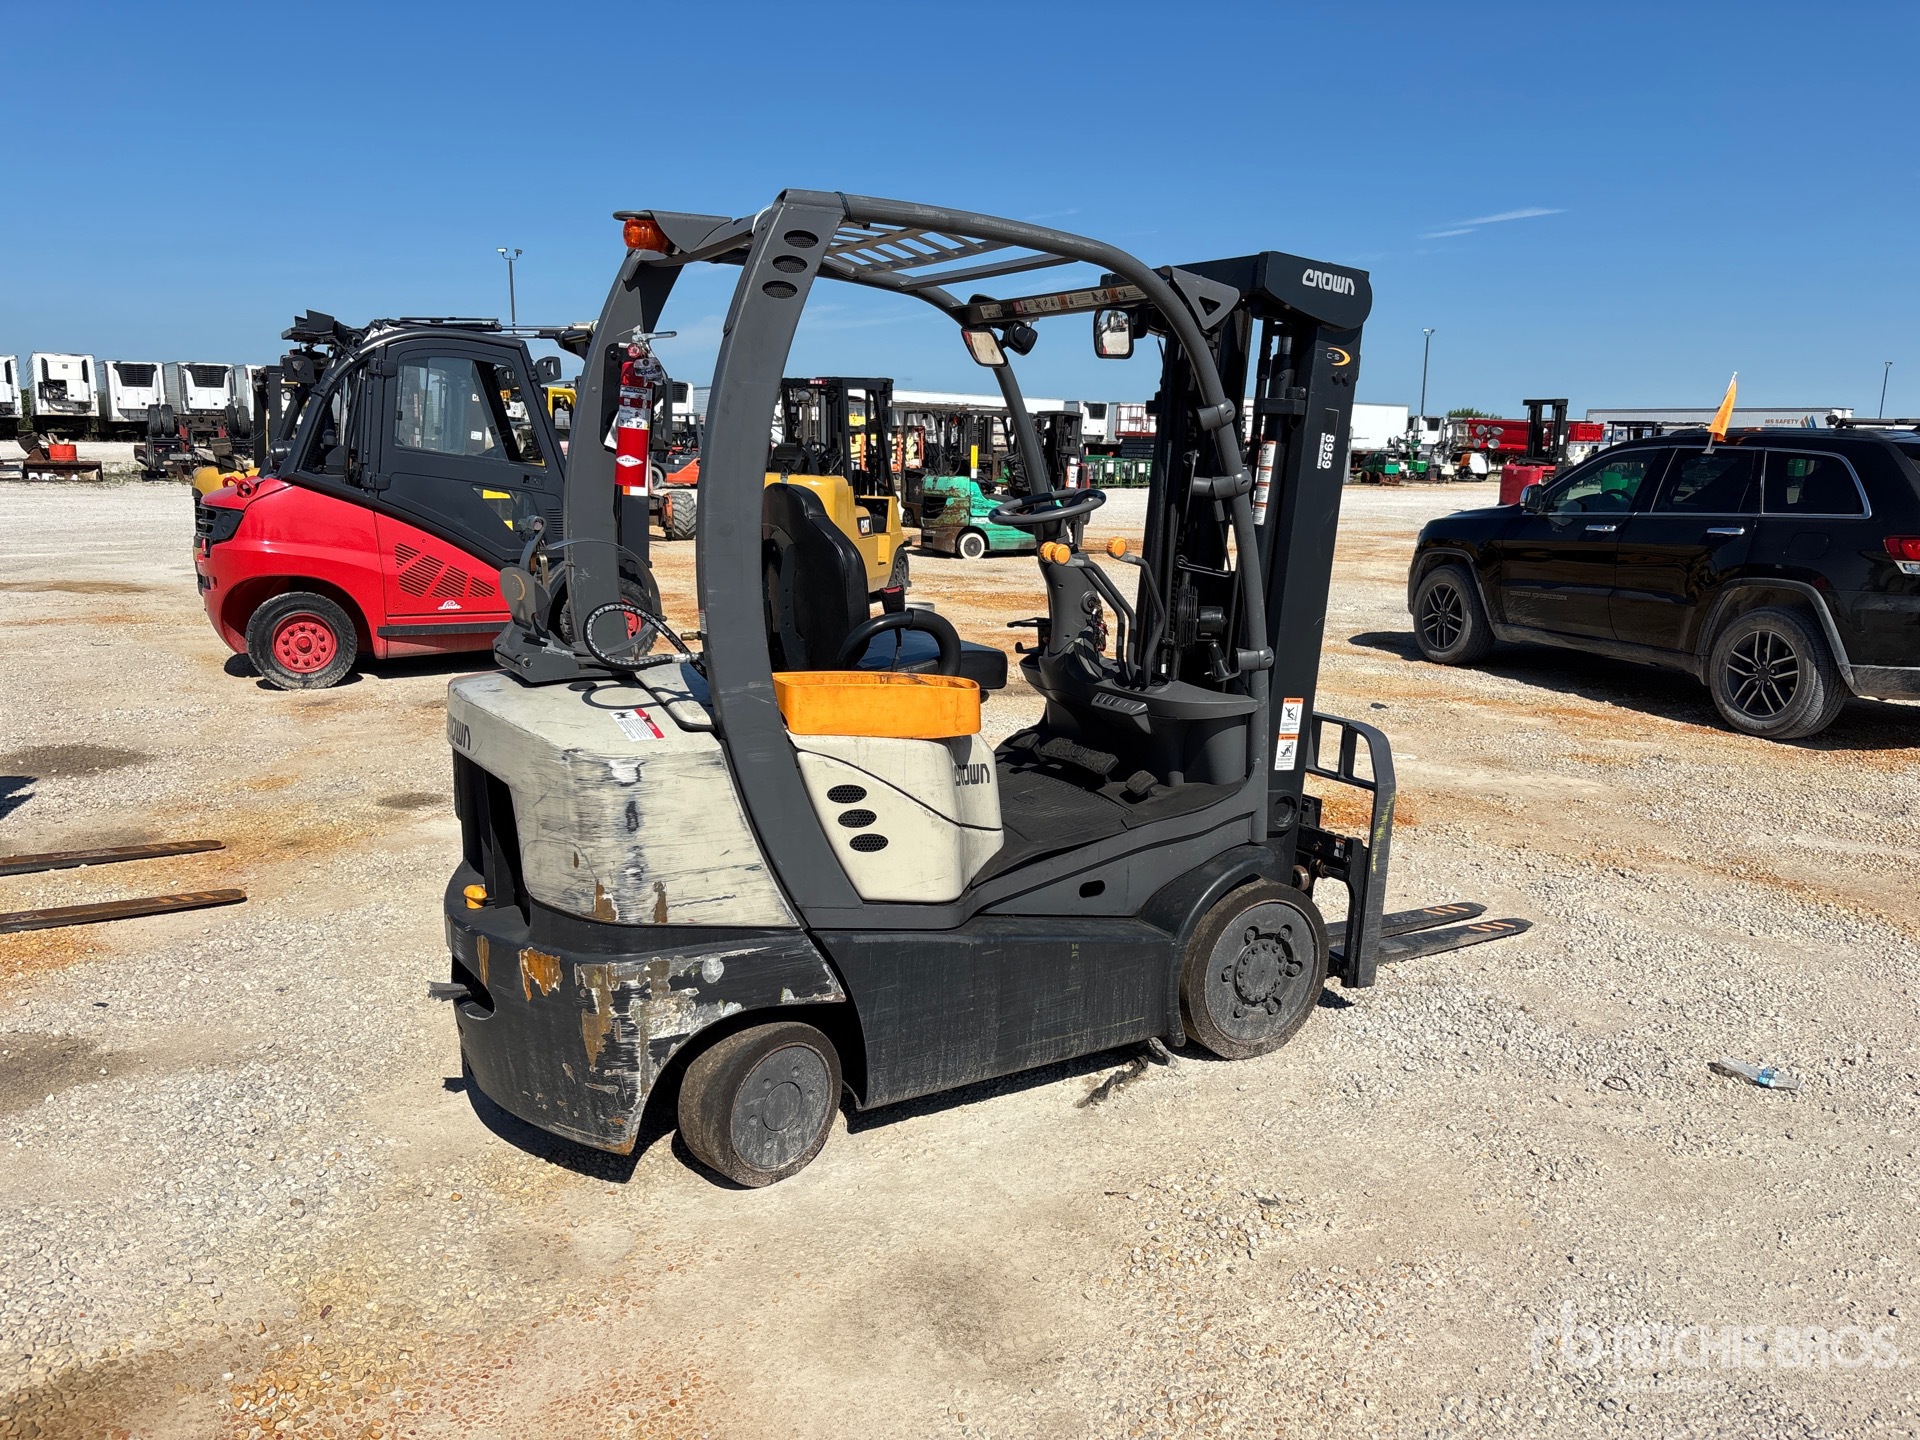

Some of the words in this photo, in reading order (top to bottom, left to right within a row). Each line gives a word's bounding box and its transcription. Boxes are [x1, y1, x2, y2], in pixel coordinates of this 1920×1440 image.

[1302, 268, 1356, 296] CROWN
[1321, 433, 1336, 469] 8959
[437, 599, 463, 610] Linde
[953, 763, 991, 787] CROWN
